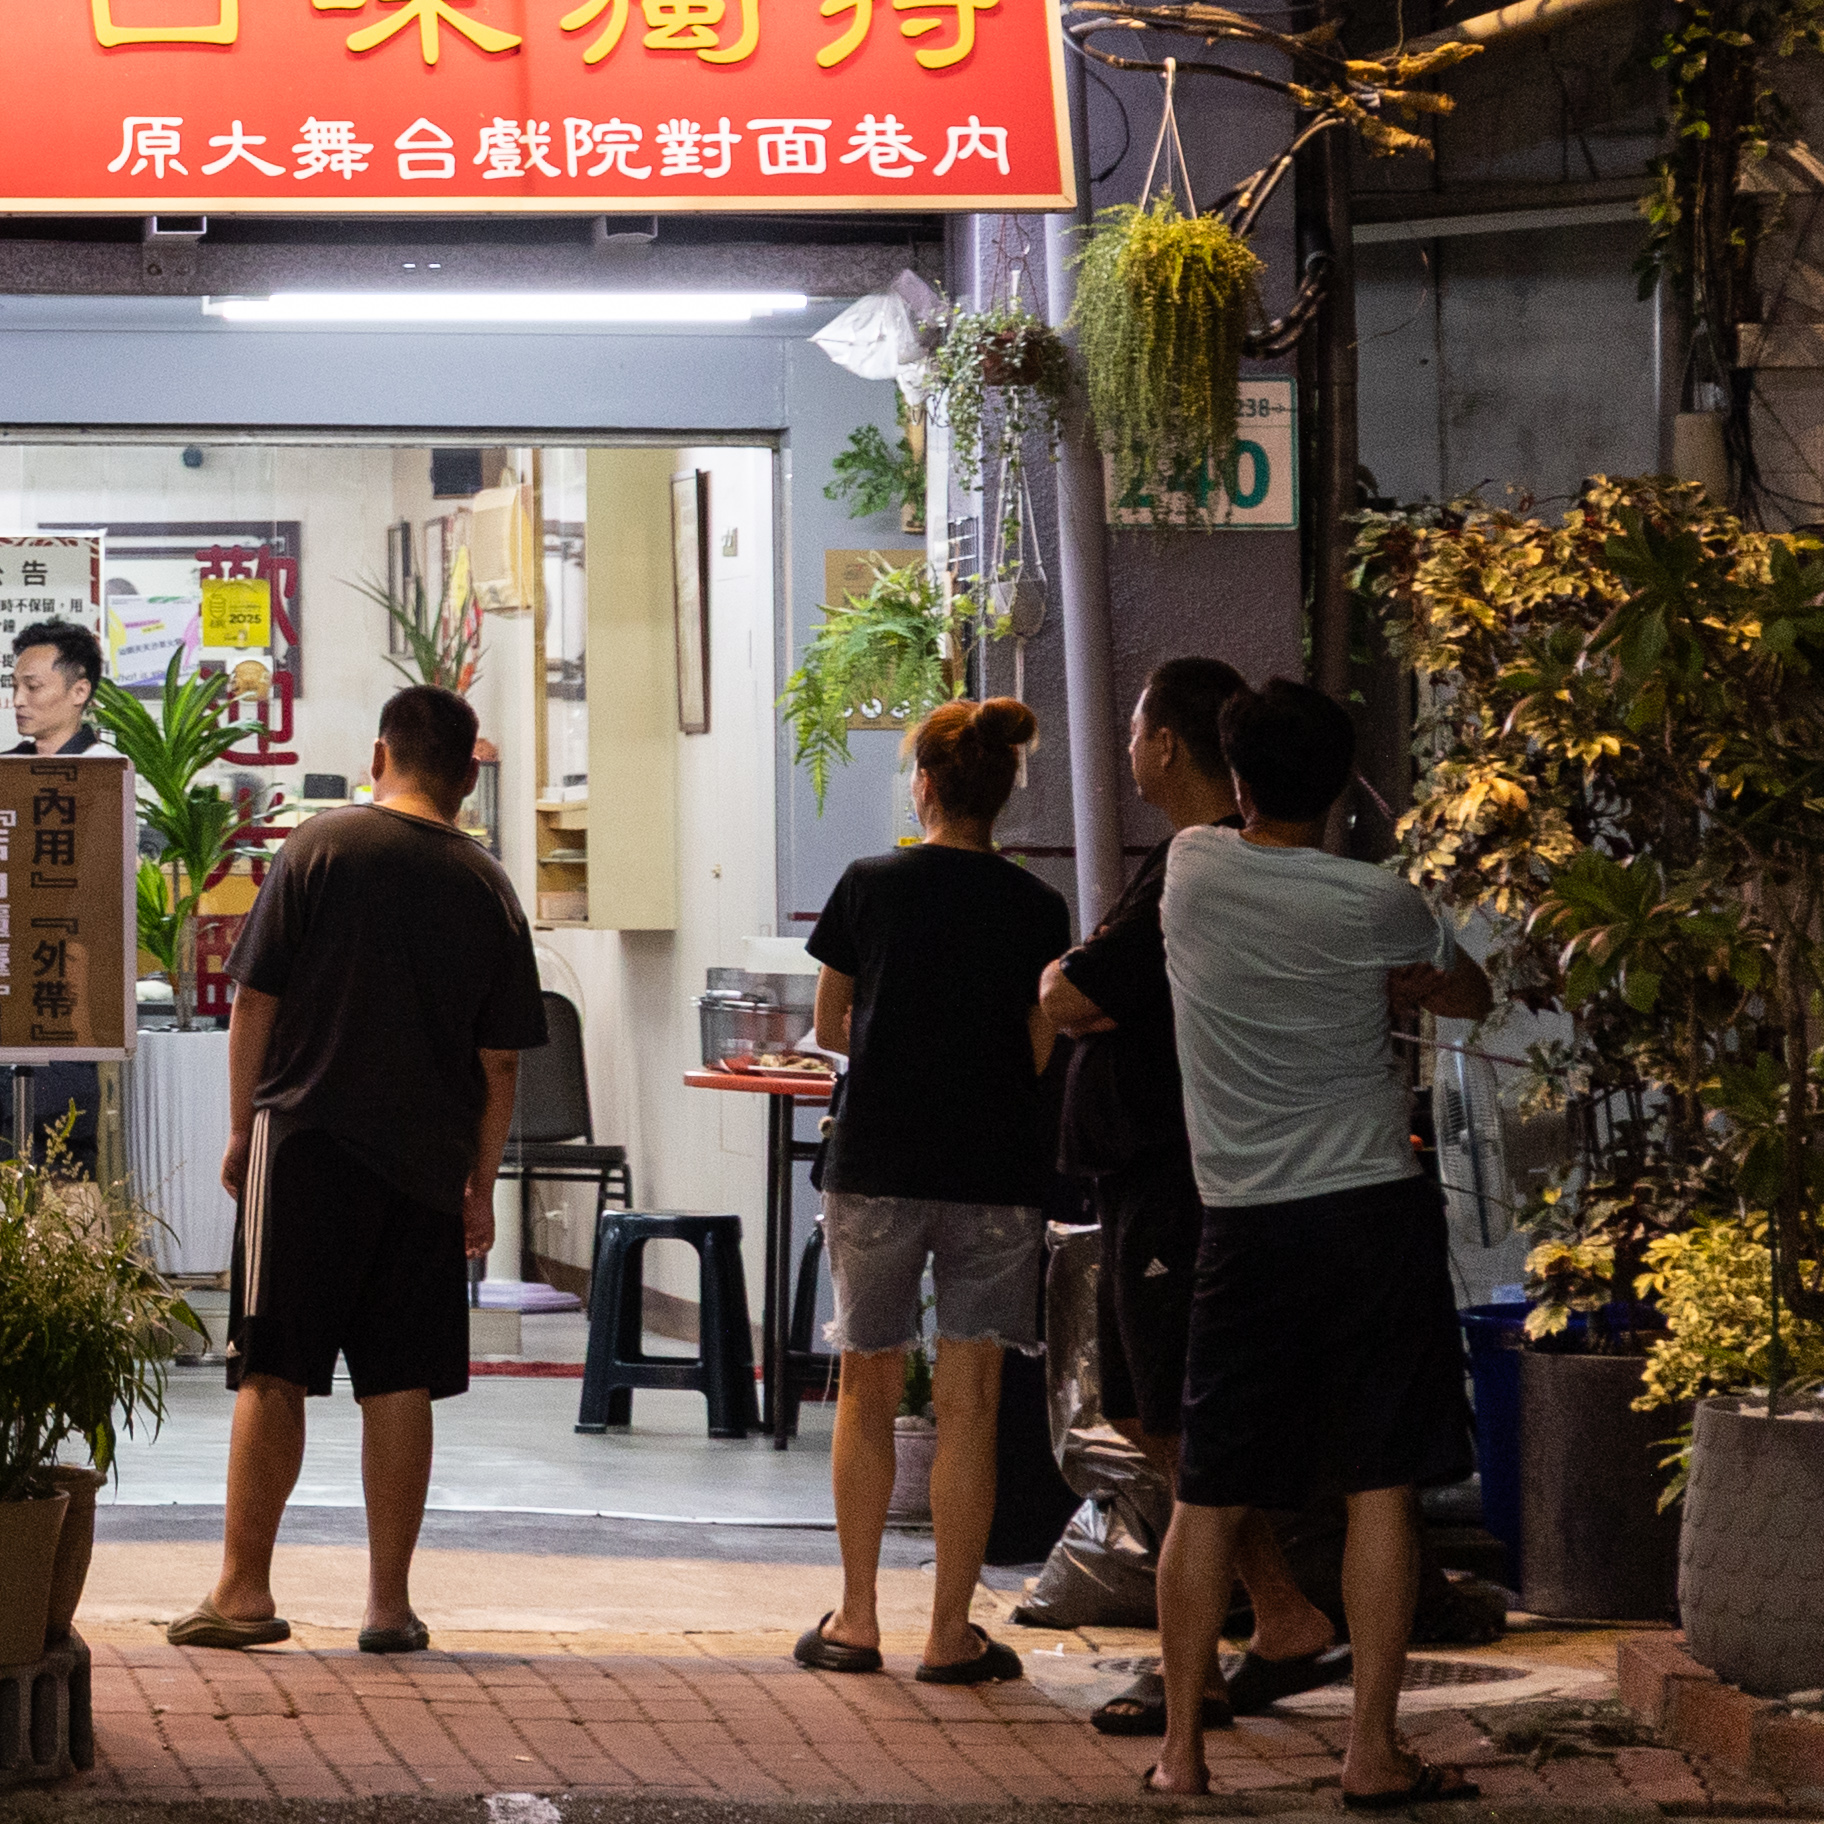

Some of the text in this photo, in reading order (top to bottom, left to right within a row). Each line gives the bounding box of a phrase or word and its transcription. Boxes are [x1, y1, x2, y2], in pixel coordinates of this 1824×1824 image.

[108, 114, 1010, 179] 原大舞台戲院對面巷內
[229, 613, 262, 624] 2025
